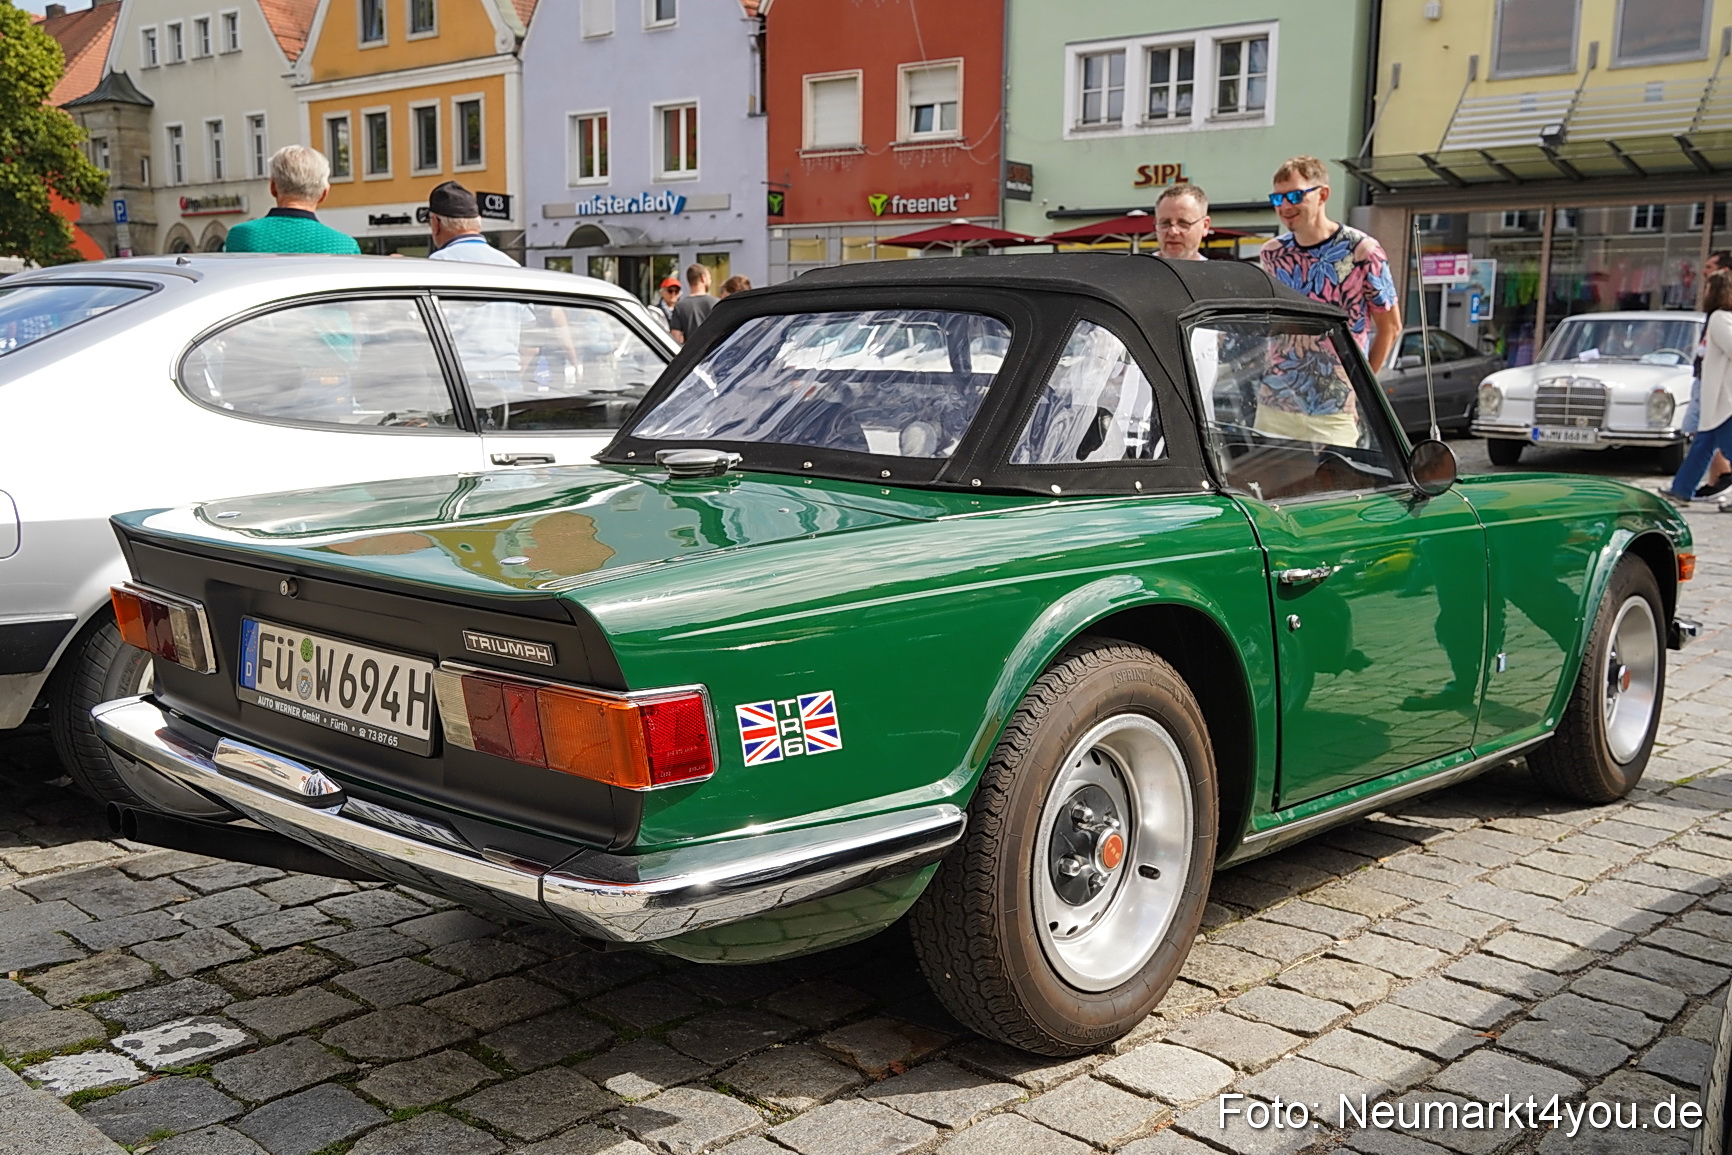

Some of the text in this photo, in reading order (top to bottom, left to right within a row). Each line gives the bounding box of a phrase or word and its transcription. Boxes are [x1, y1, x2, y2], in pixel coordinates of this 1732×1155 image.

[1133, 163, 1189, 187] SIPL
[485, 194, 504, 210] CB
[892, 194, 958, 213] freenet
[467, 634, 549, 661] TRIUMPH
[245, 661, 253, 677] D
[258, 632, 295, 692] FÜ
[1116, 669, 1148, 684] SPRINT
[257, 695, 274, 708] AUTO
[274, 700, 301, 718] WERNER
[301, 709, 321, 723] GmbH
[330, 717, 348, 732] Fürth
[776, 698, 804, 757] TR6
